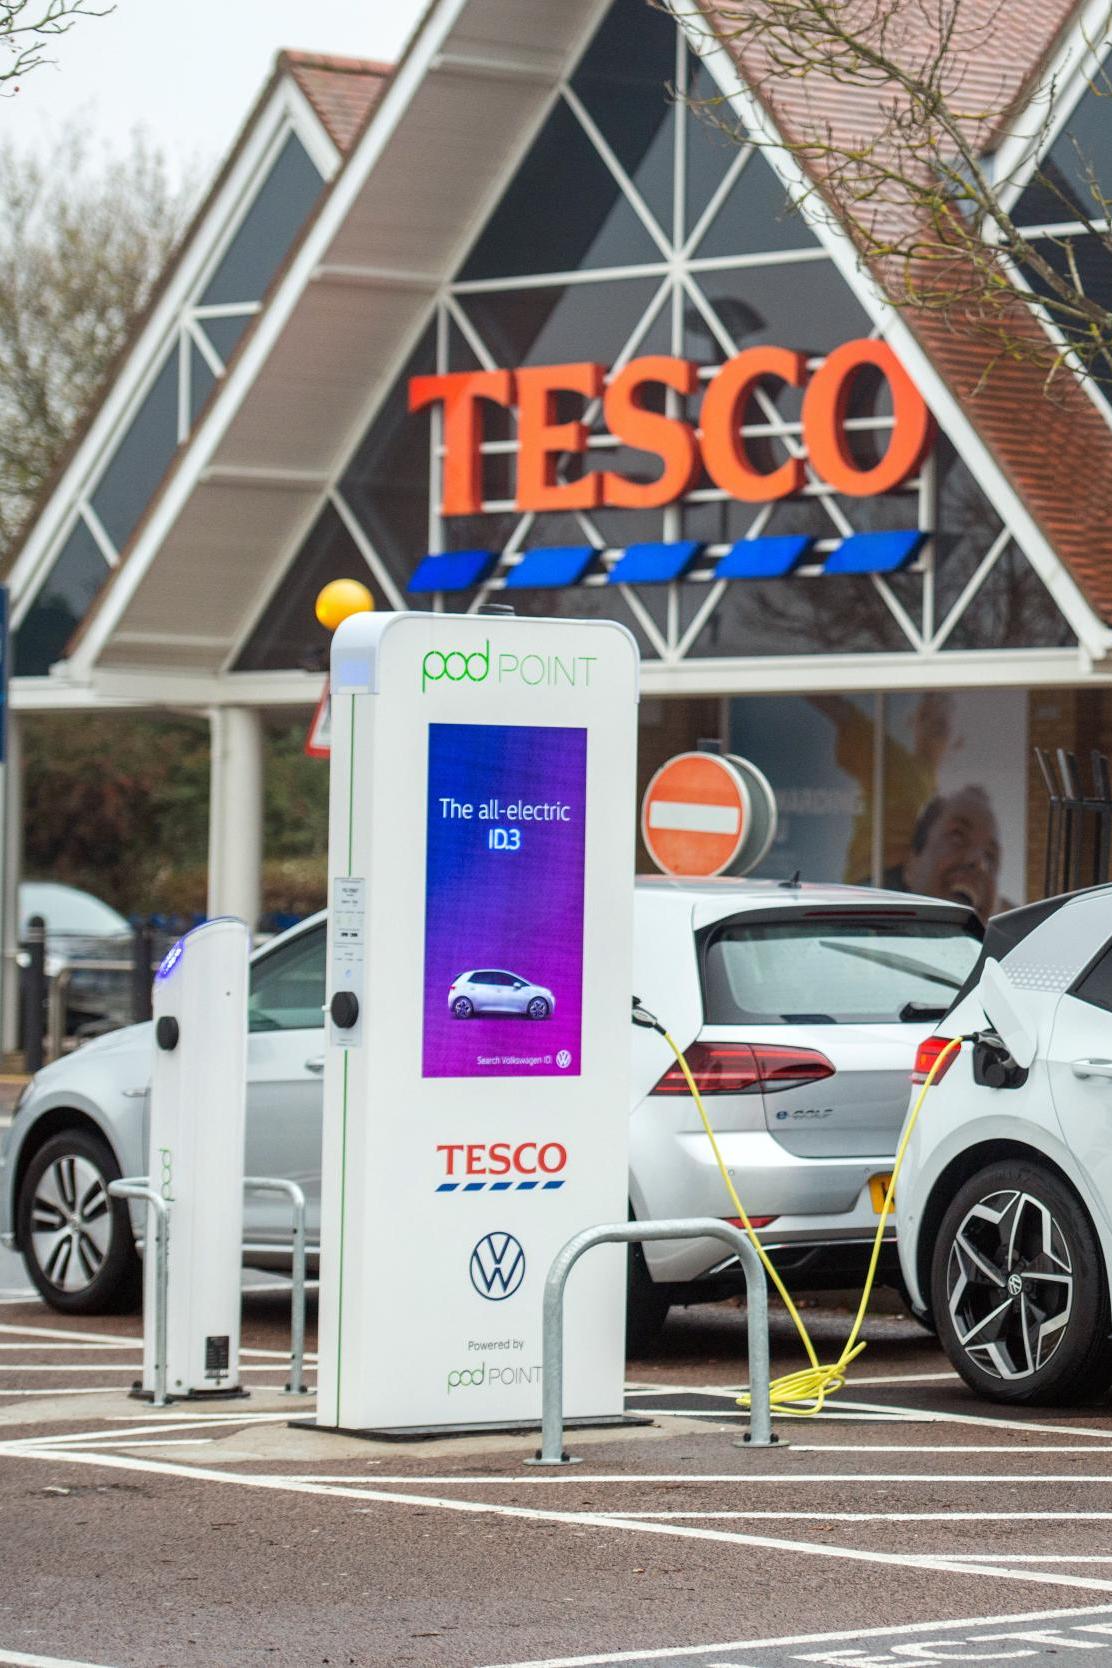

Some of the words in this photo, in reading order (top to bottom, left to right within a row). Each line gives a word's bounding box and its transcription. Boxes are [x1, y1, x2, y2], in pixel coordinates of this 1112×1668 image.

[407, 338, 931, 517] TESCO
[422, 638, 490, 694] pod
[498, 653, 598, 687] POINT
[439, 797, 474, 819] The
[478, 798, 572, 822] all-electric
[488, 828, 521, 851] ID.3
[476, 1055, 500, 1066] Search
[501, 1055, 542, 1067] Volkswagen
[435, 1142, 568, 1176] TESCO
[467, 1338, 510, 1351] Powered
[513, 1337, 524, 1351] by
[447, 1361, 486, 1395] pod
[488, 1365, 543, 1386] POINT
